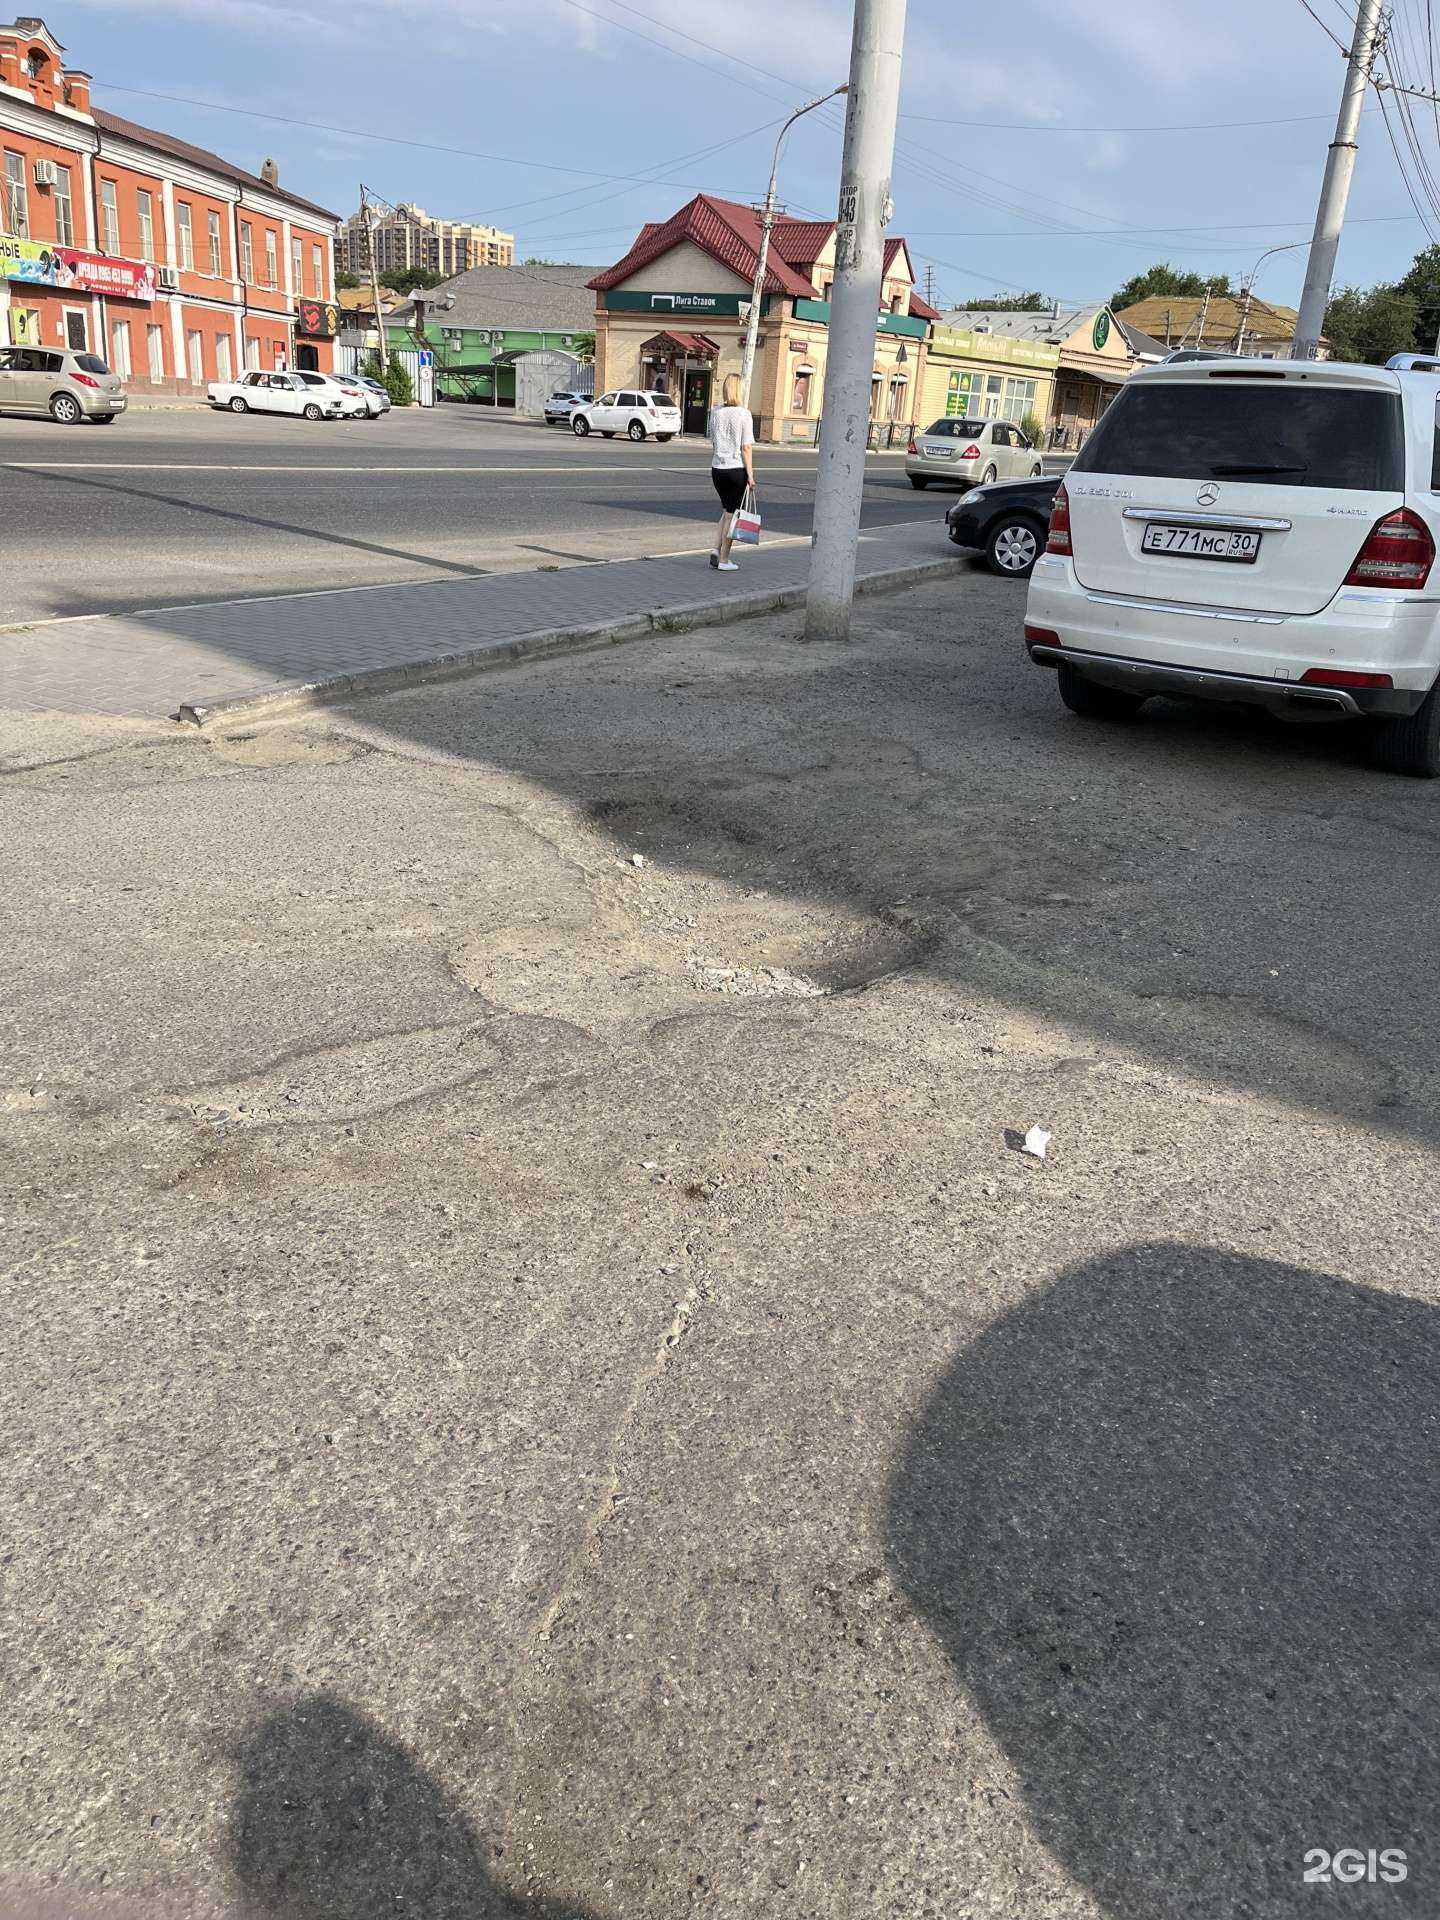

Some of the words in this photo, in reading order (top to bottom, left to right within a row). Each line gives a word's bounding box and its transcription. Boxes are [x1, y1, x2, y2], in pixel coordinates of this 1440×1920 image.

[675, 296, 692, 305] Лига
[692, 296, 716, 306] Ставок
[1151, 529, 1225, 553] Е771МС
[1231, 534, 1252, 550] 30
